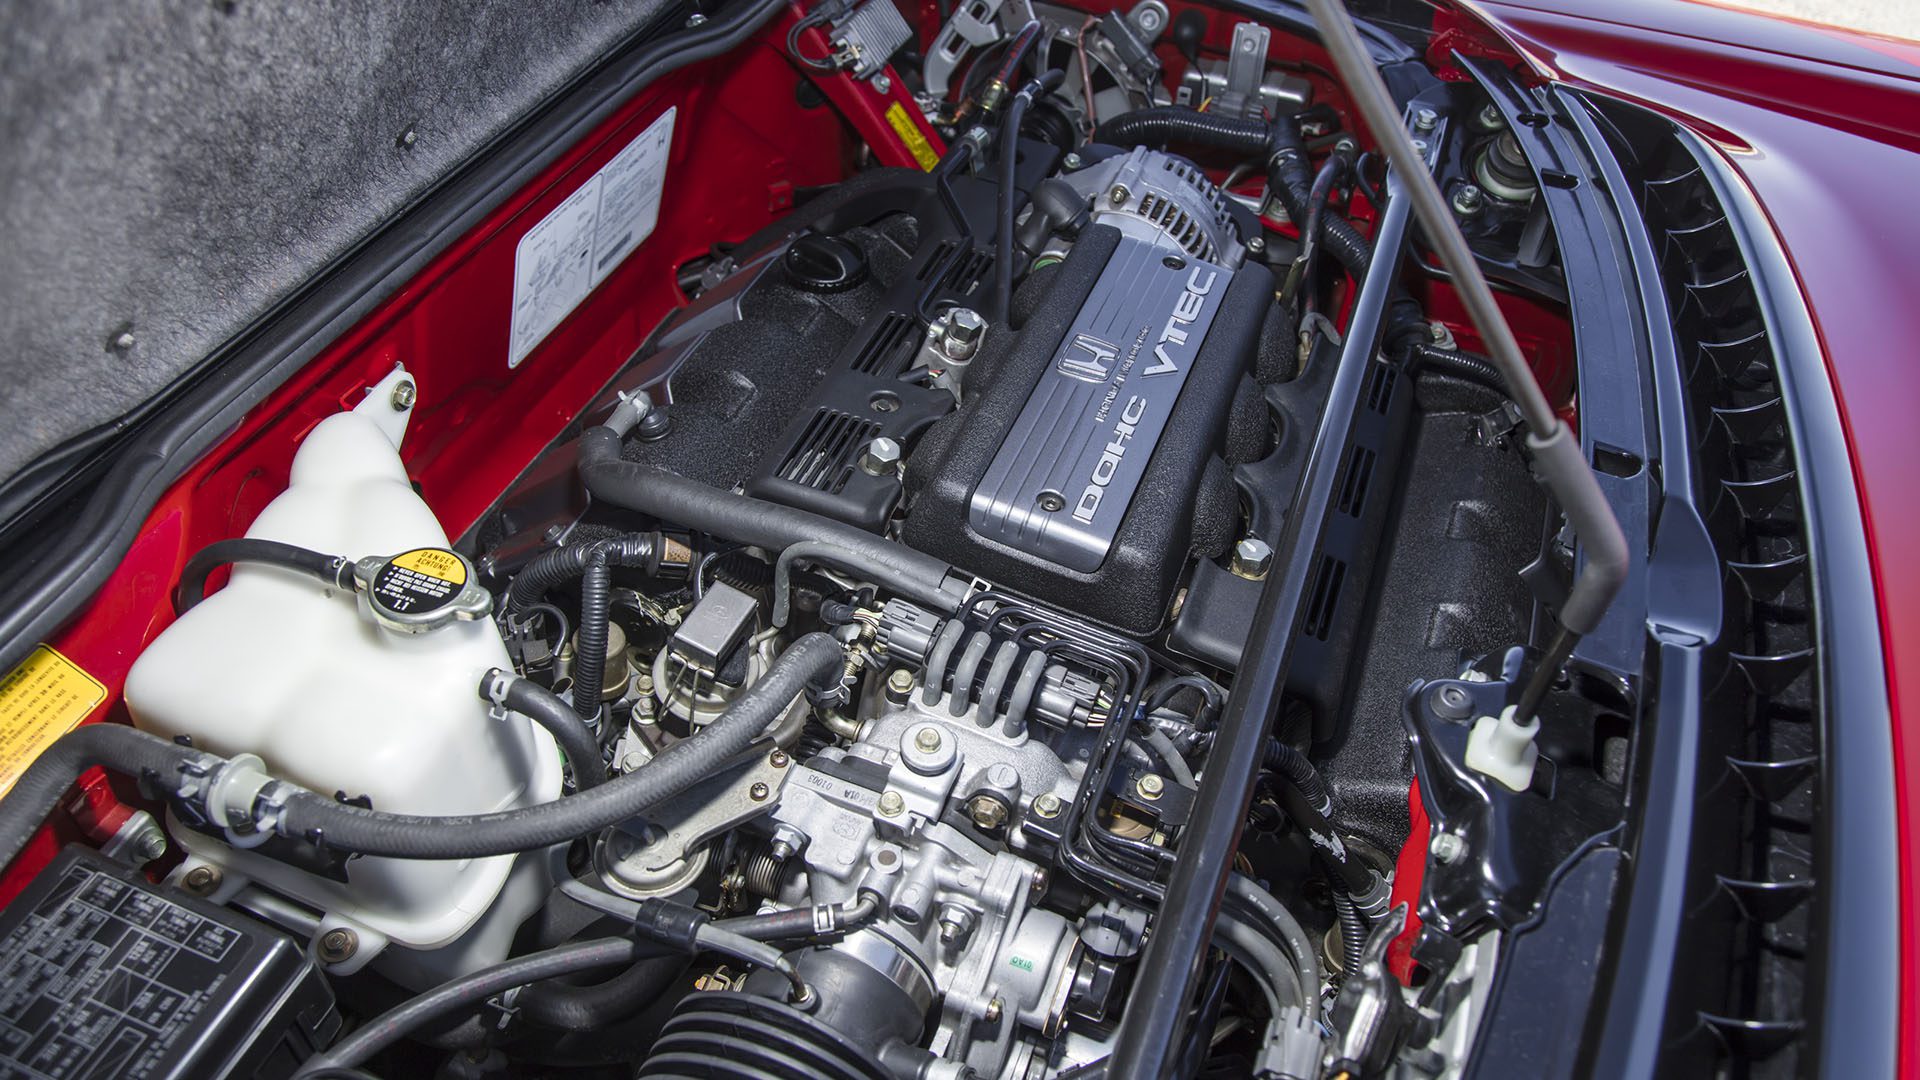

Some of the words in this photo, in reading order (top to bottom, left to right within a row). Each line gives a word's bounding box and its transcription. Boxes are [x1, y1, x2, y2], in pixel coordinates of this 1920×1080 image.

[1140, 266, 1217, 378] VTEC
[1072, 395, 1147, 524] DOHC
[416, 557, 451, 571] ACHTUNG!
[421, 551, 456, 566] DANGER
[393, 599, 410, 611] 1.1
